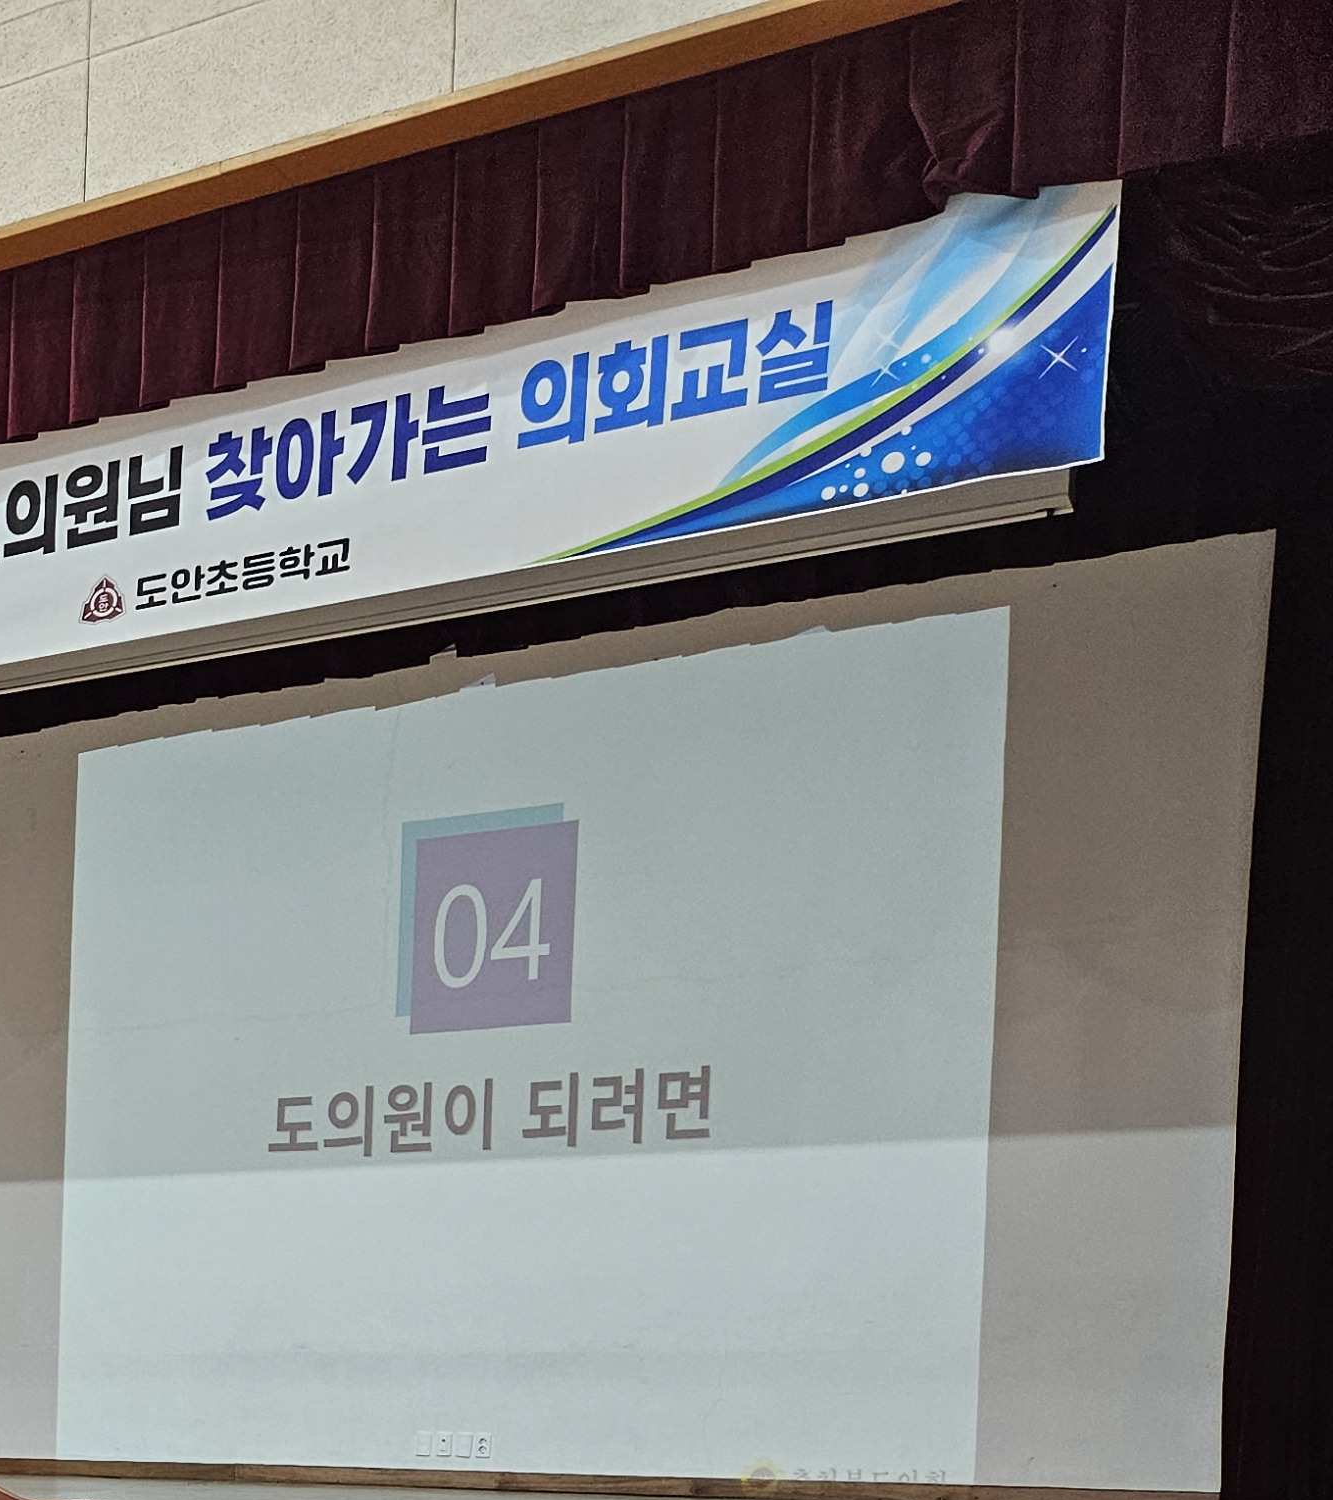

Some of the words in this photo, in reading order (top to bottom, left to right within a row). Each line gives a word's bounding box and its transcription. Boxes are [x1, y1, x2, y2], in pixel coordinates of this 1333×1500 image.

[205, 385, 492, 521] 찾아가는
[517, 299, 834, 450] 의회교실
[135, 537, 351, 611] 도안초등학교
[434, 877, 551, 989] 04
[268, 1077, 494, 1158] 도의원이
[522, 1064, 712, 1149] 되려면
